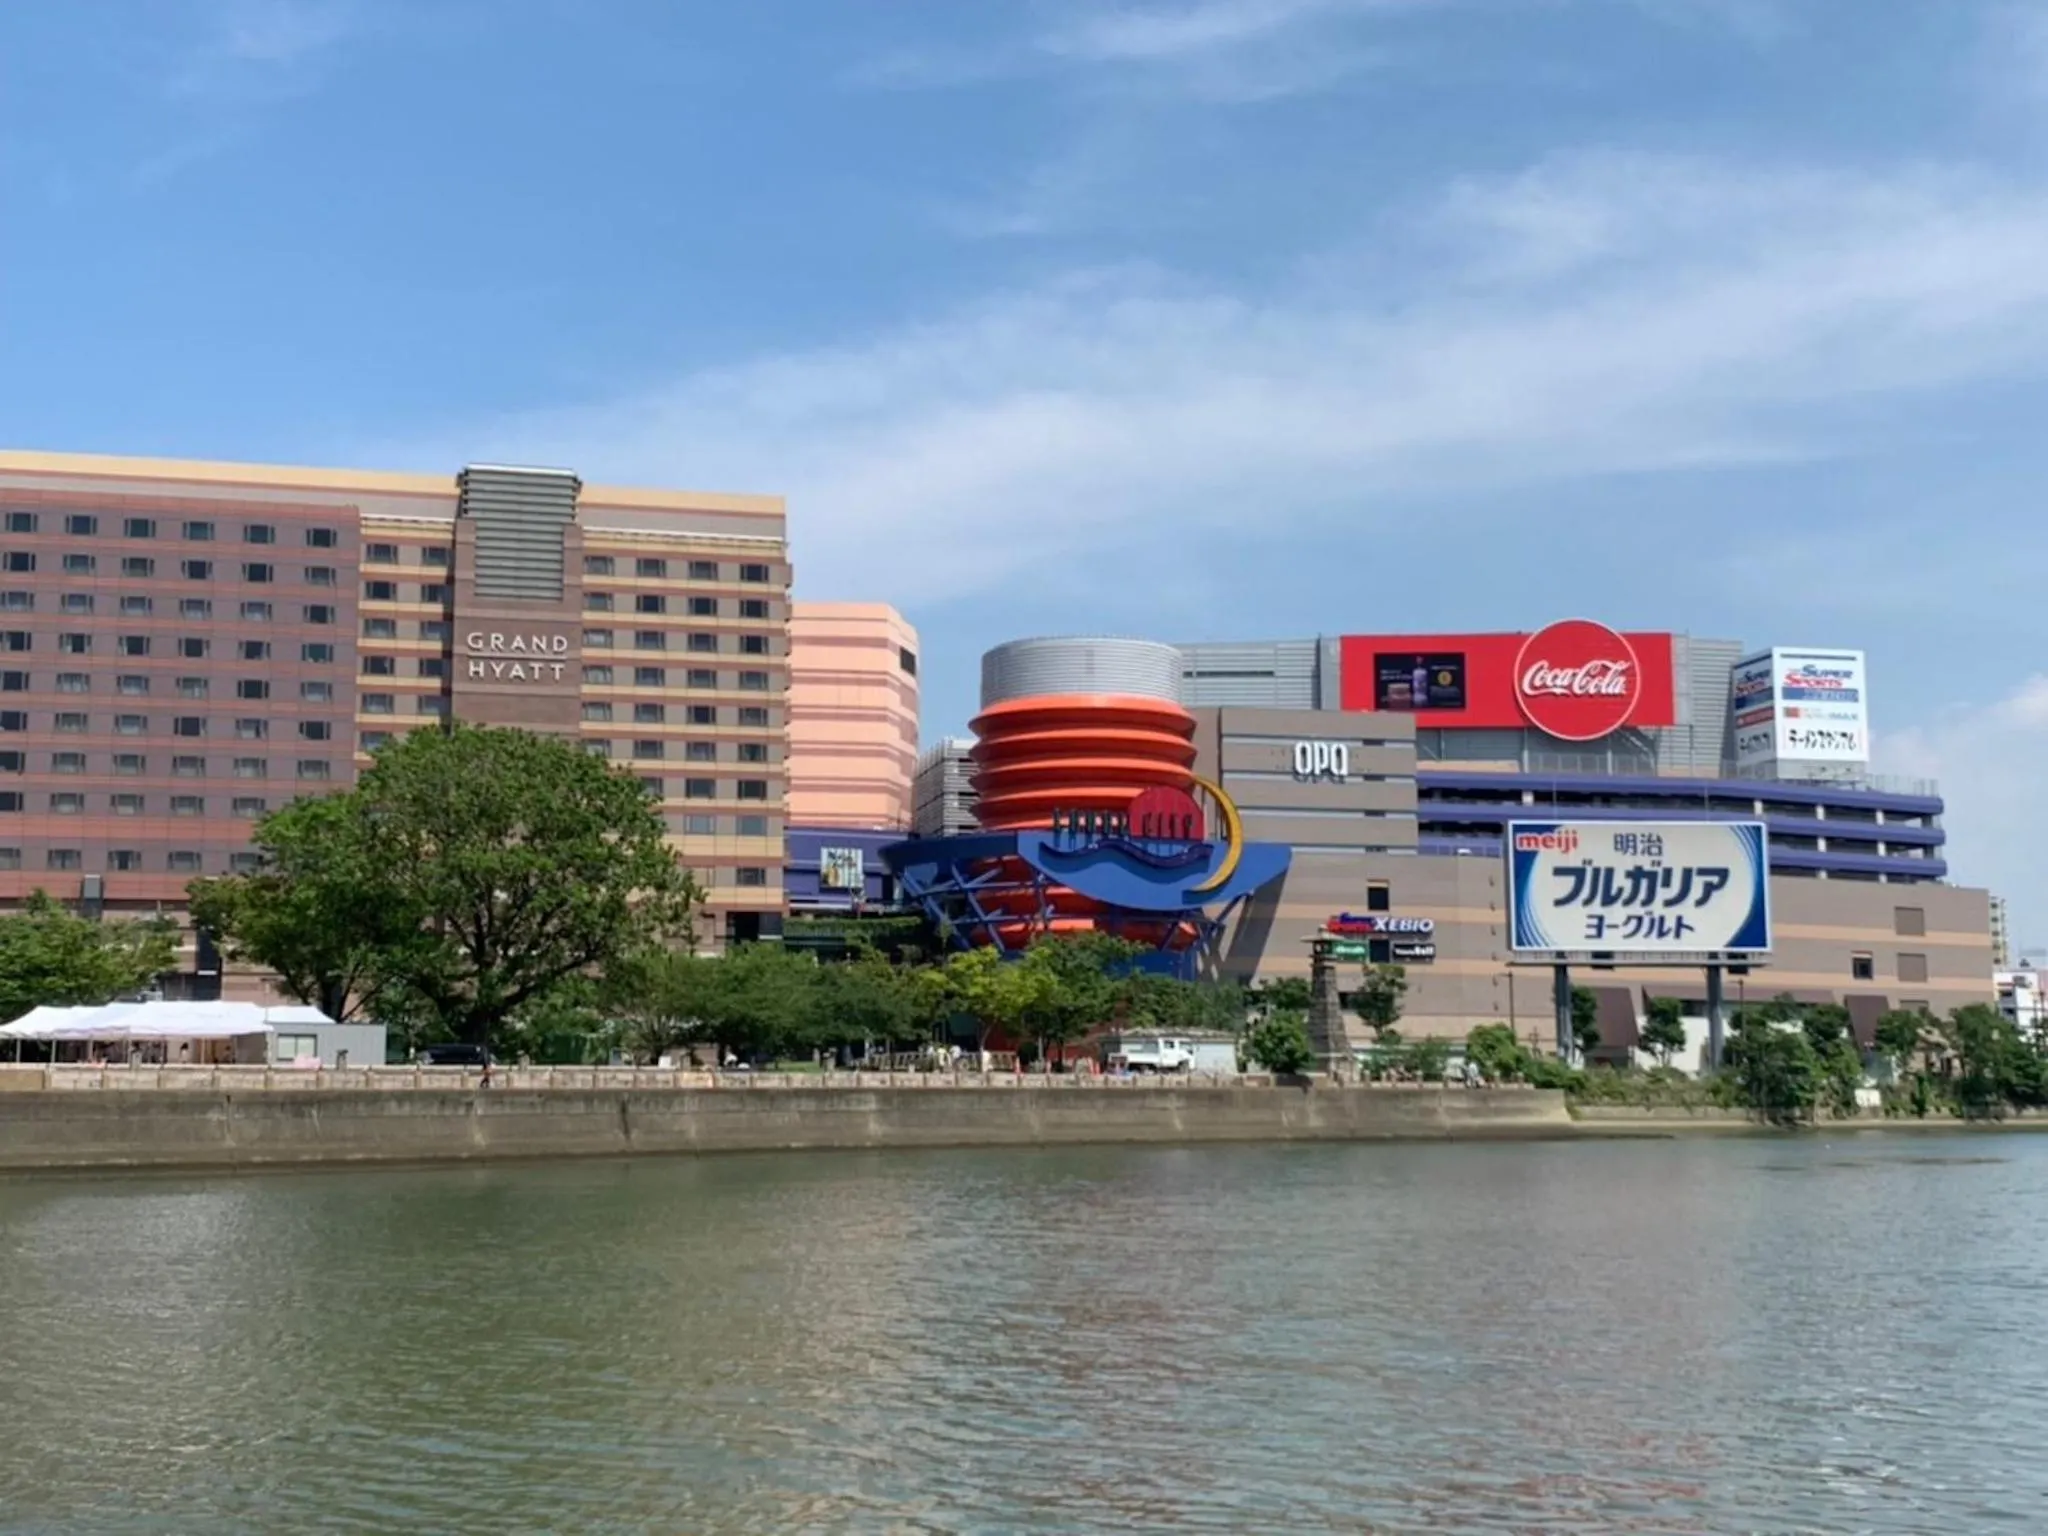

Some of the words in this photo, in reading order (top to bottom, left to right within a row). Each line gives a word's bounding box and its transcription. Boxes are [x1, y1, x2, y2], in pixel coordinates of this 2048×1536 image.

[467, 632, 568, 652] GRAND
[468, 660, 565, 680] HYATT
[1522, 659, 1632, 696] Coca-Cola
[1516, 829, 1579, 853] meiji
[1613, 832, 1663, 857] 明治
[1552, 860, 1730, 908] ブルガリア
[1374, 917, 1434, 933] XEBIO
[1584, 911, 1694, 939] ヨーグルト
